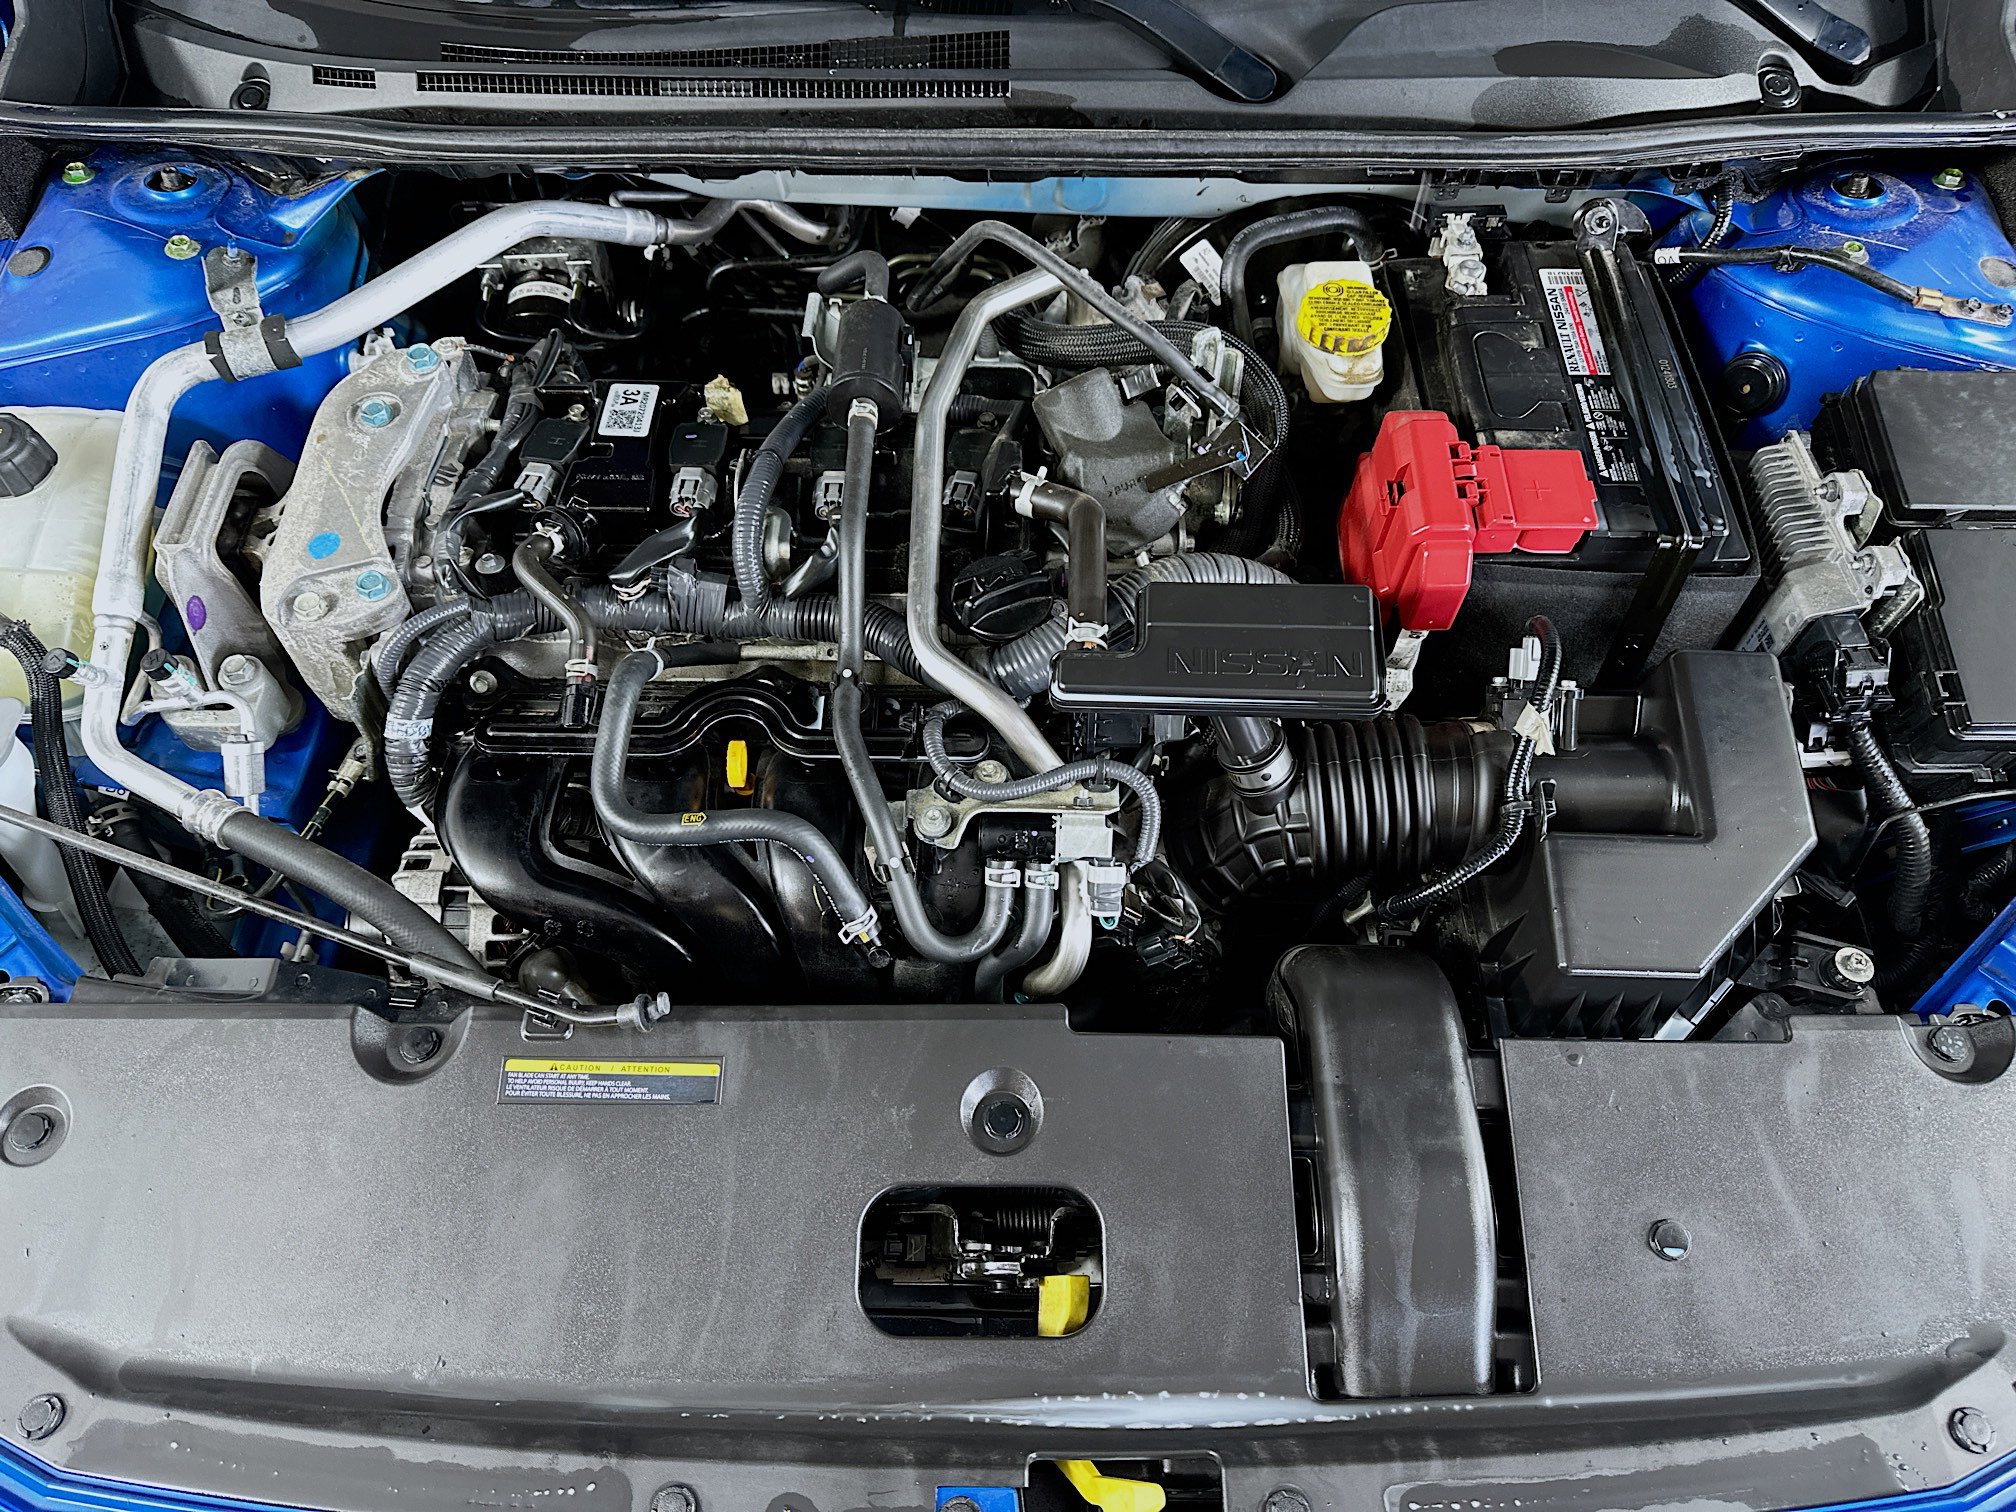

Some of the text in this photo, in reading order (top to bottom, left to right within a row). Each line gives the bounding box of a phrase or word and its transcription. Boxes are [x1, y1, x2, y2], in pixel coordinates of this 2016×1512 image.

[1546, 288, 1568, 330] NISSAN
[1560, 333, 1580, 372] RENAULT
[620, 390, 640, 405] 3A
[1168, 648, 1364, 678] NISSAN
[684, 814, 702, 823] ENG
[560, 1063, 600, 1071] CAUTION
